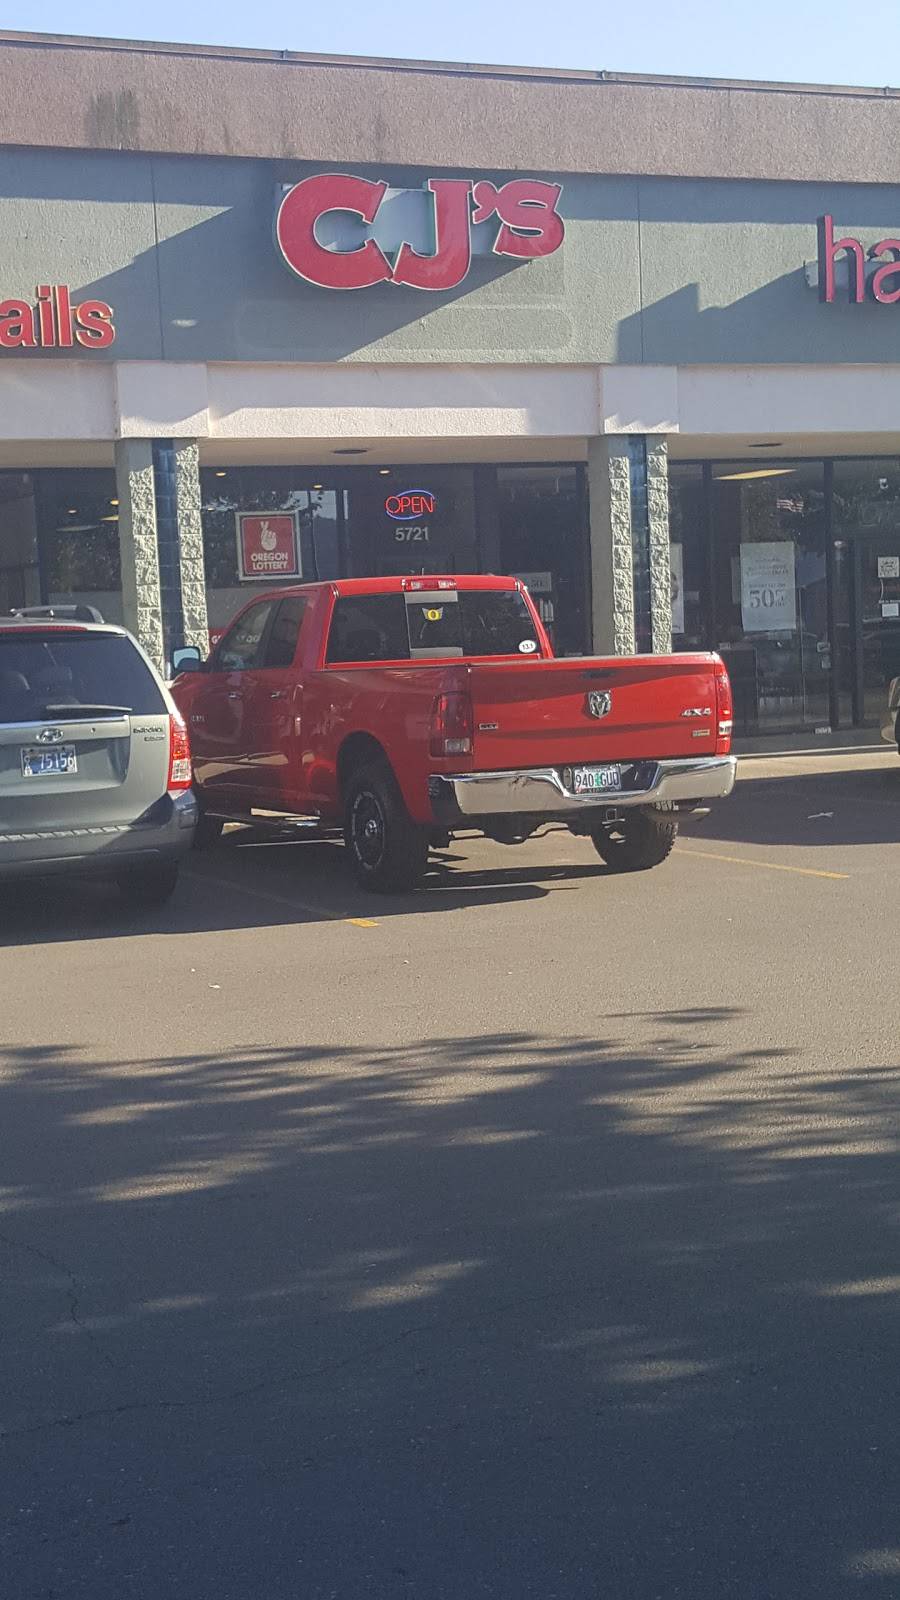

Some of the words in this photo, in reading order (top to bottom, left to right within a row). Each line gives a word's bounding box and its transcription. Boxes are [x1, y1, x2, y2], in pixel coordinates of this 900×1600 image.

[824, 214, 900, 303] ha
[0, 284, 116, 349] ails
[385, 496, 434, 514] OPEN
[394, 527, 429, 541] 5721
[251, 552, 289, 562] OREGON
[252, 561, 288, 570] LOTTERY
[40, 753, 74, 769] 75156
[575, 773, 594, 787] 940
